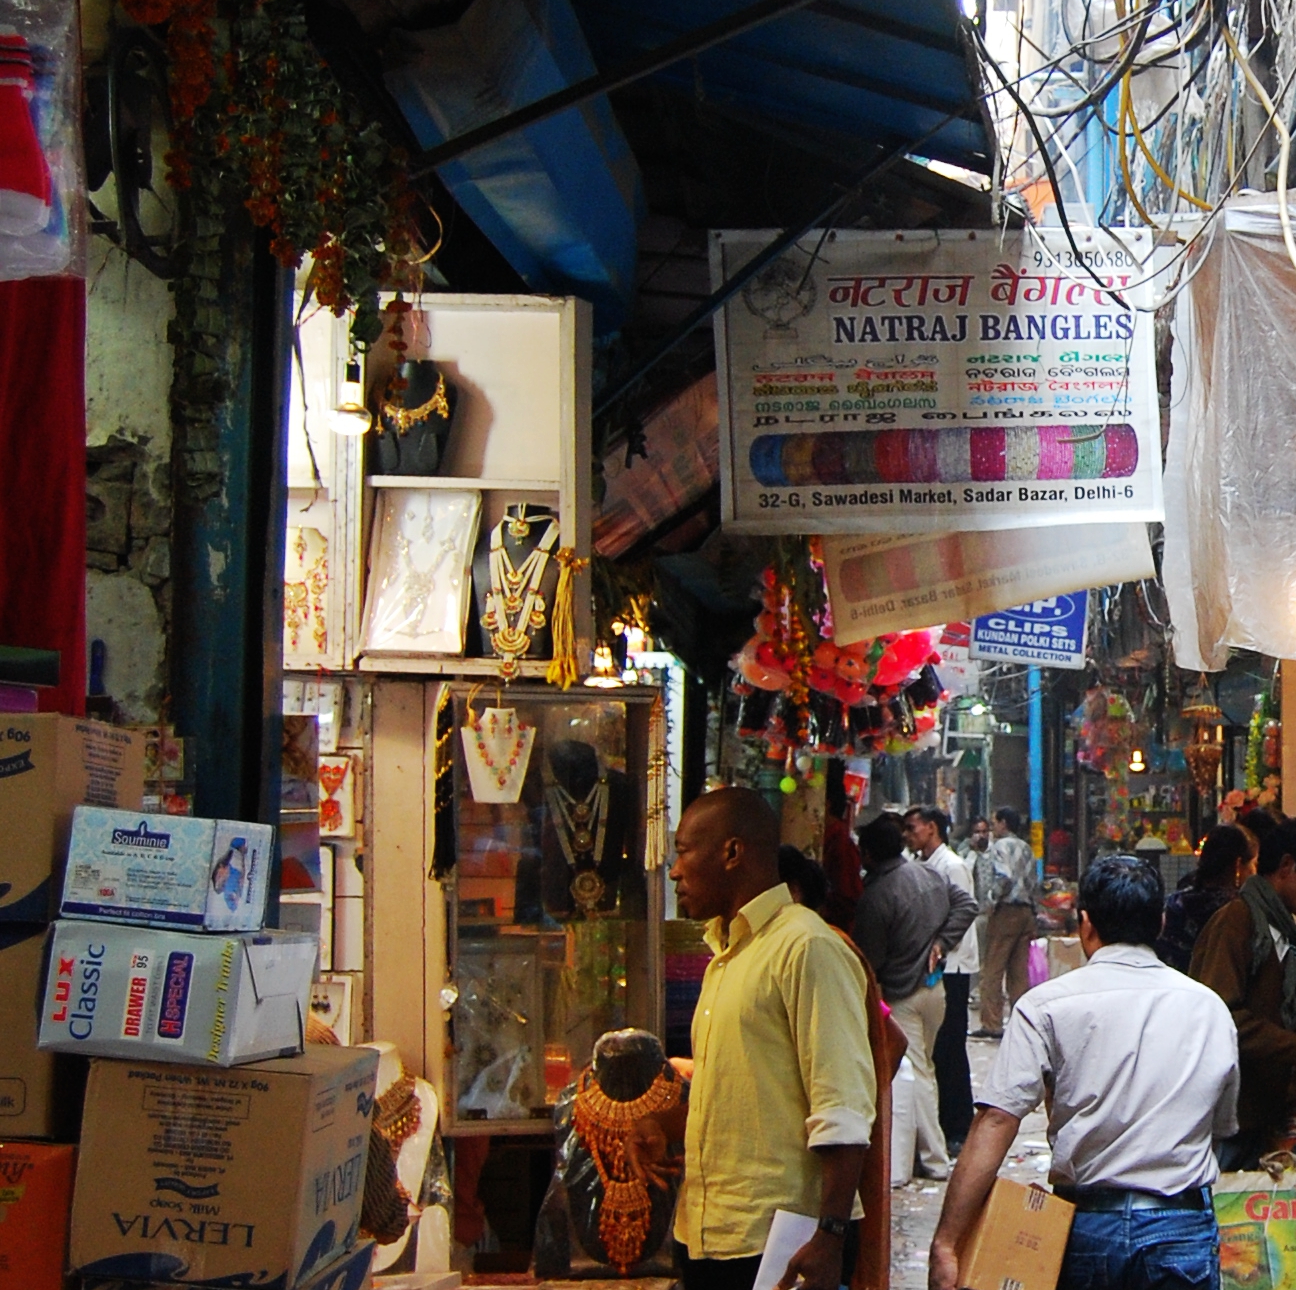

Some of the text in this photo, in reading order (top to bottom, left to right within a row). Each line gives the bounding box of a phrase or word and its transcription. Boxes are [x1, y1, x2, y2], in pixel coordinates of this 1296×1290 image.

[827, 275, 975, 308] नटराज
[833, 313, 1134, 344] NATRAJ BANGLES
[758, 485, 1134, 508] 32-G, Sawadesi Market, Sadar Bazar, Delhi-6
[977, 629, 1076, 651] KUNDAN POLKI SETS
[987, 618, 1068, 637] CLIPS
[978, 644, 1072, 662] METAL COLLECTION
[114, 830, 168, 849] Souminie
[53, 956, 75, 1022] LUX
[69, 944, 105, 1040] Classic
[124, 955, 148, 1037] DRAWER 95
[206, 998, 227, 1063] Designer
[149, 1198, 183, 1213] Soap
[111, 1212, 255, 1248] LERVIA
